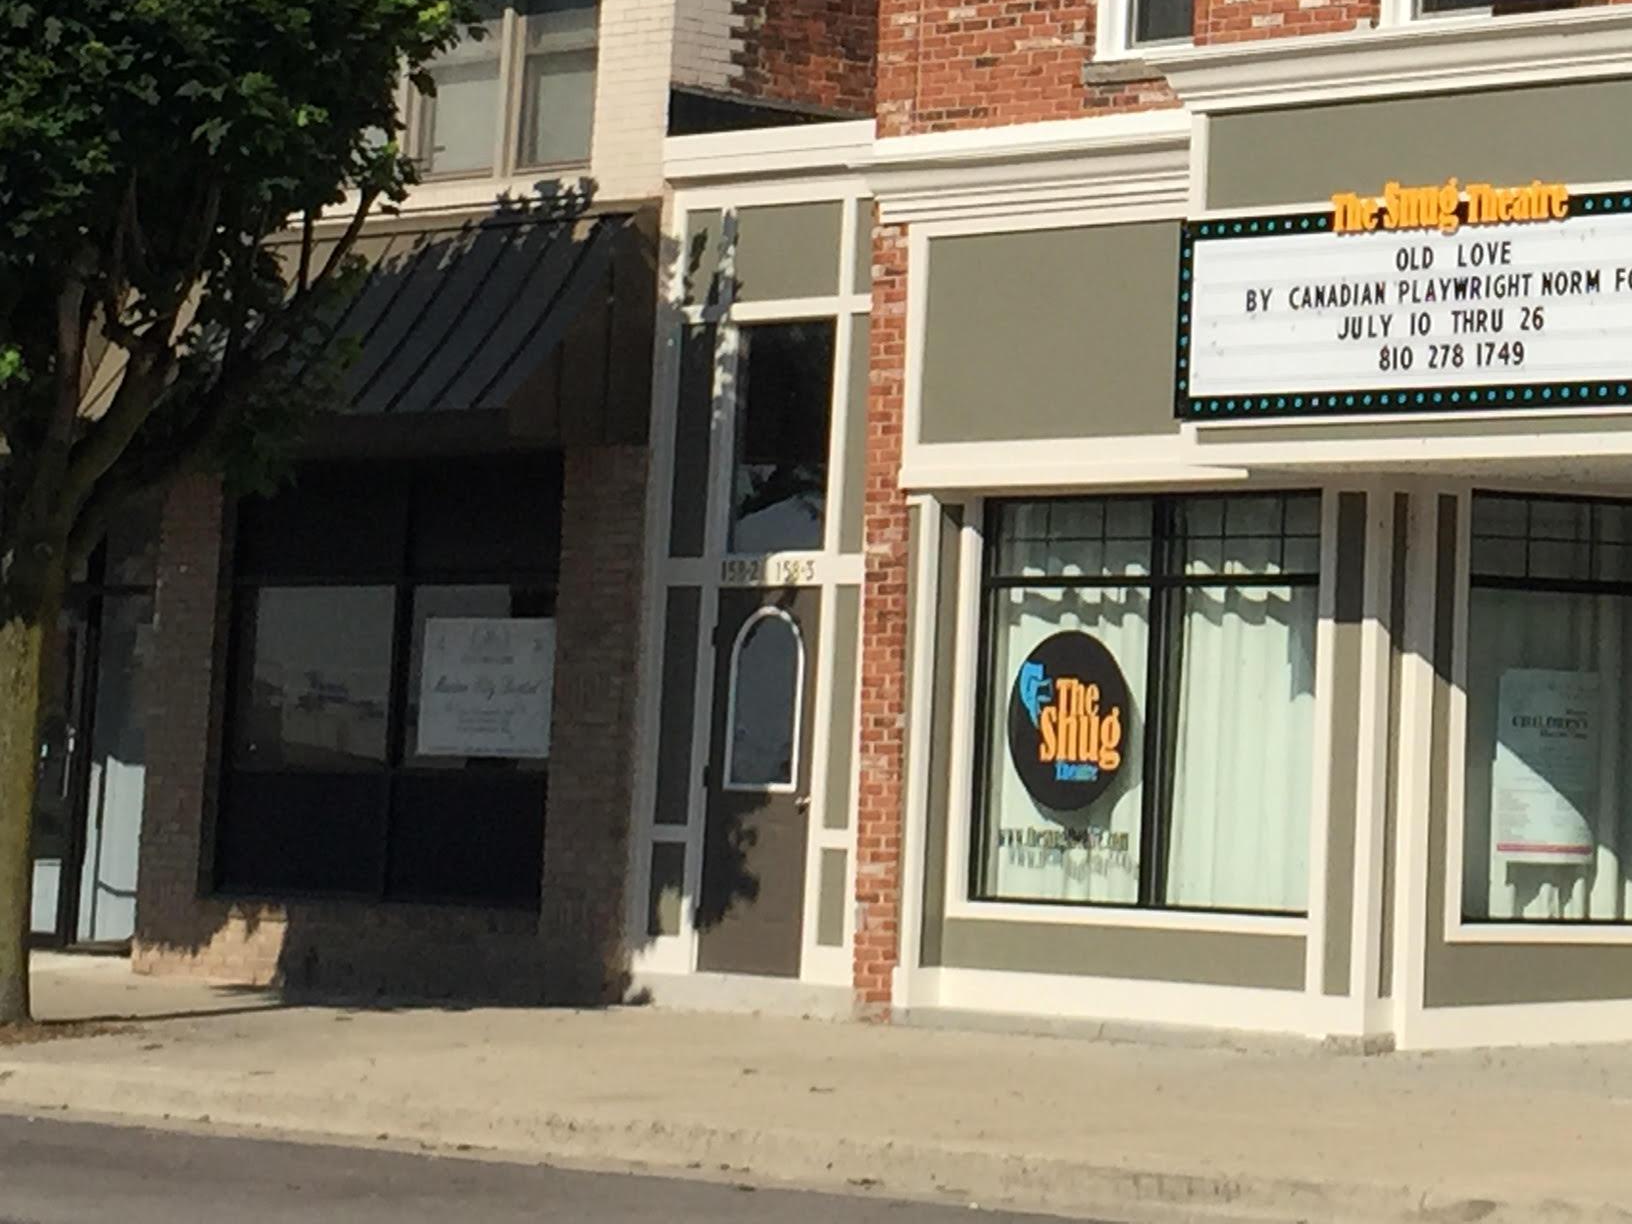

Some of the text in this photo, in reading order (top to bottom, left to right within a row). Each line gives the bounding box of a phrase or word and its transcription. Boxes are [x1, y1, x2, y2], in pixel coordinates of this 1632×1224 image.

[1331, 177, 1569, 235] The Snug Theatre
[1396, 241, 1512, 272] OLD LOVE
[1246, 287, 1273, 312] BY
[1288, 281, 1387, 310] CANADIAN
[1398, 272, 1534, 304] PLAYWRIGHT
[1541, 268, 1601, 297] NORM
[1337, 306, 1545, 340] JULY 10 THRU 26
[1379, 340, 1525, 371] 810 278 1749
[1055, 677, 1101, 717] The
[1039, 705, 1122, 771] Snug
